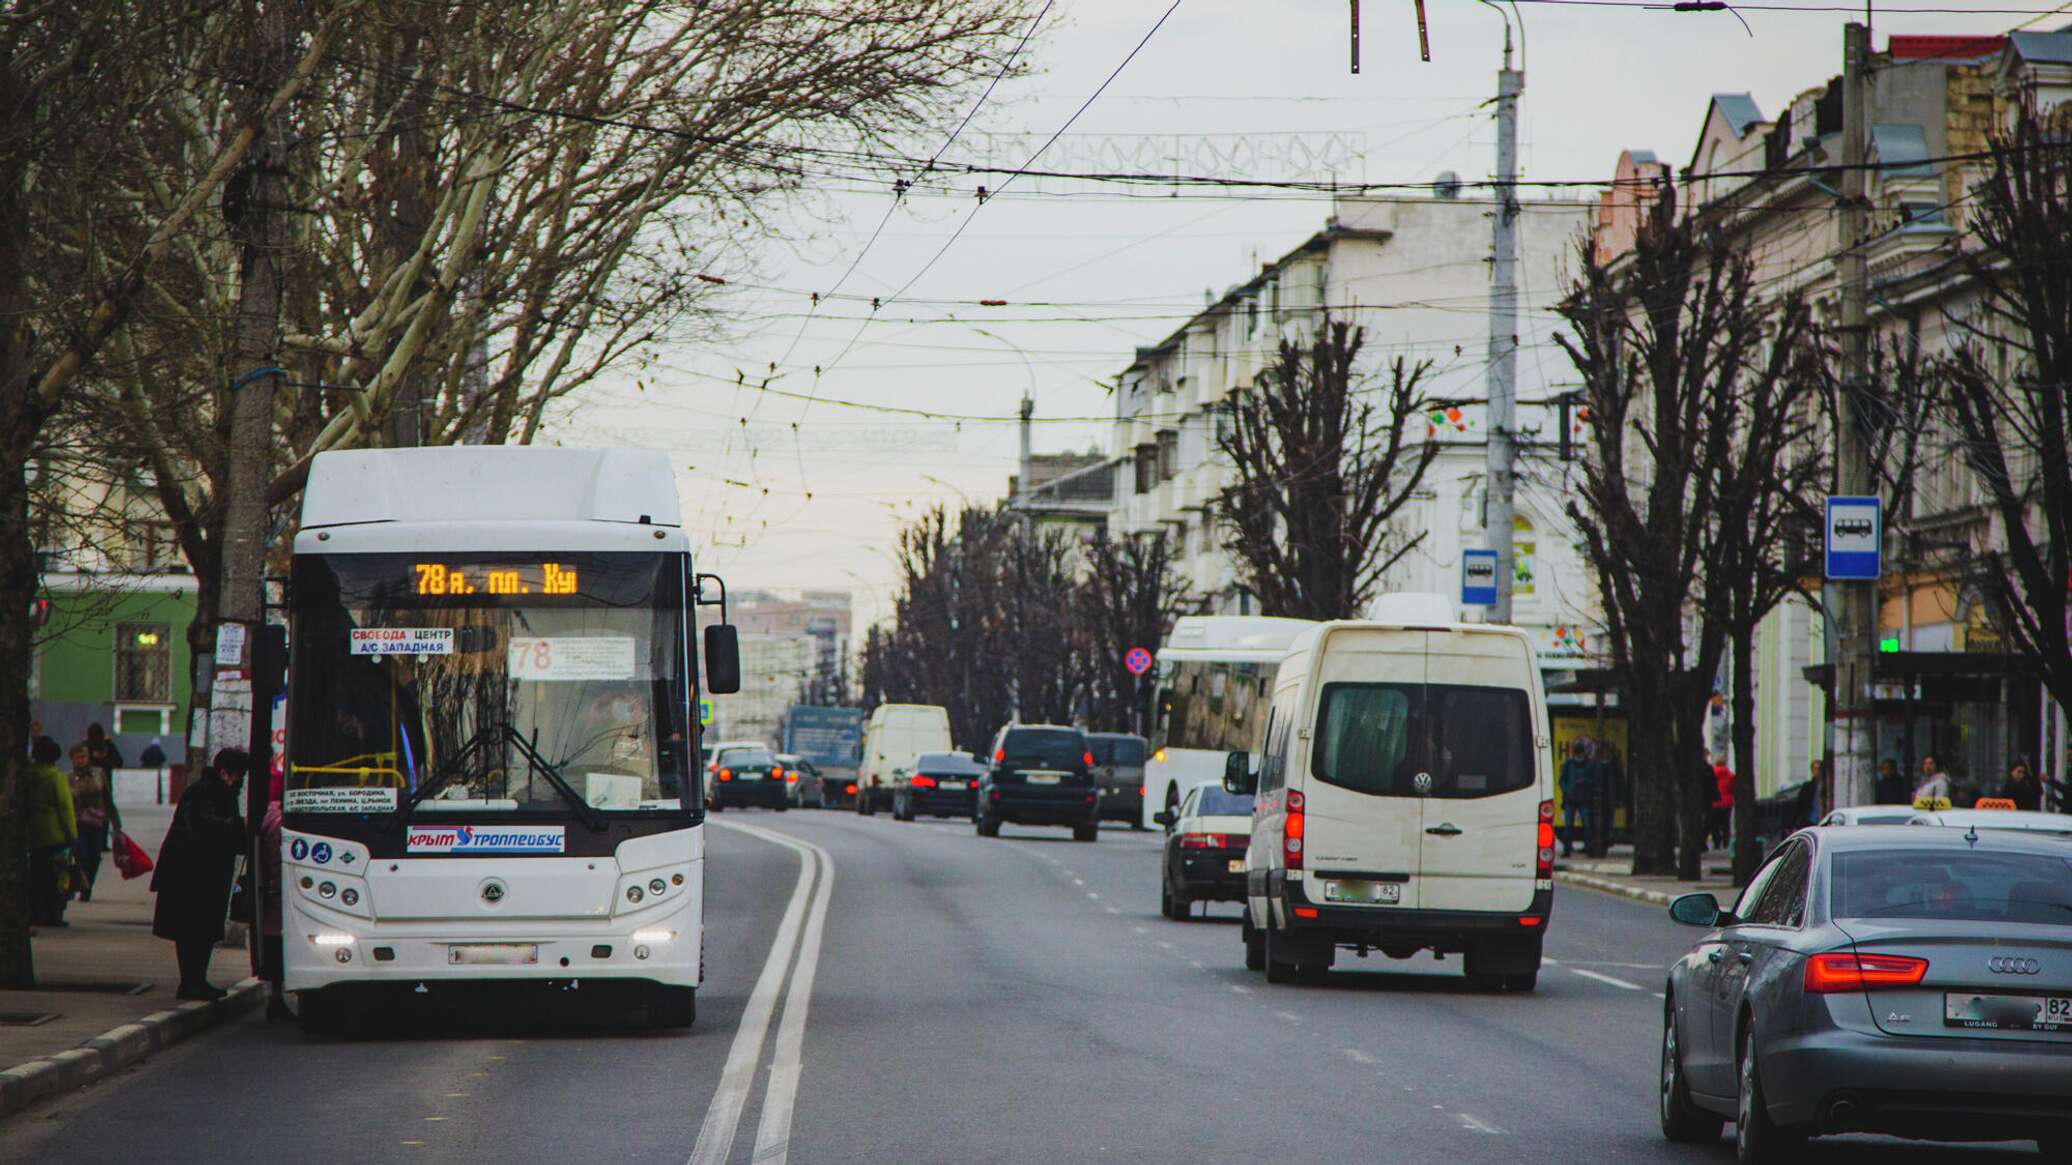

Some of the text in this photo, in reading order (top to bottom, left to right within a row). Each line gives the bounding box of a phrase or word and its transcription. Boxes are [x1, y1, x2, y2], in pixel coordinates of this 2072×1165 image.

[352, 630, 451, 640] СВОБОДА ЦЕНТР
[383, 643, 444, 652] ЗАПАДНАЯ
[512, 640, 553, 670] 78
[2049, 999, 2071, 1016] 82
